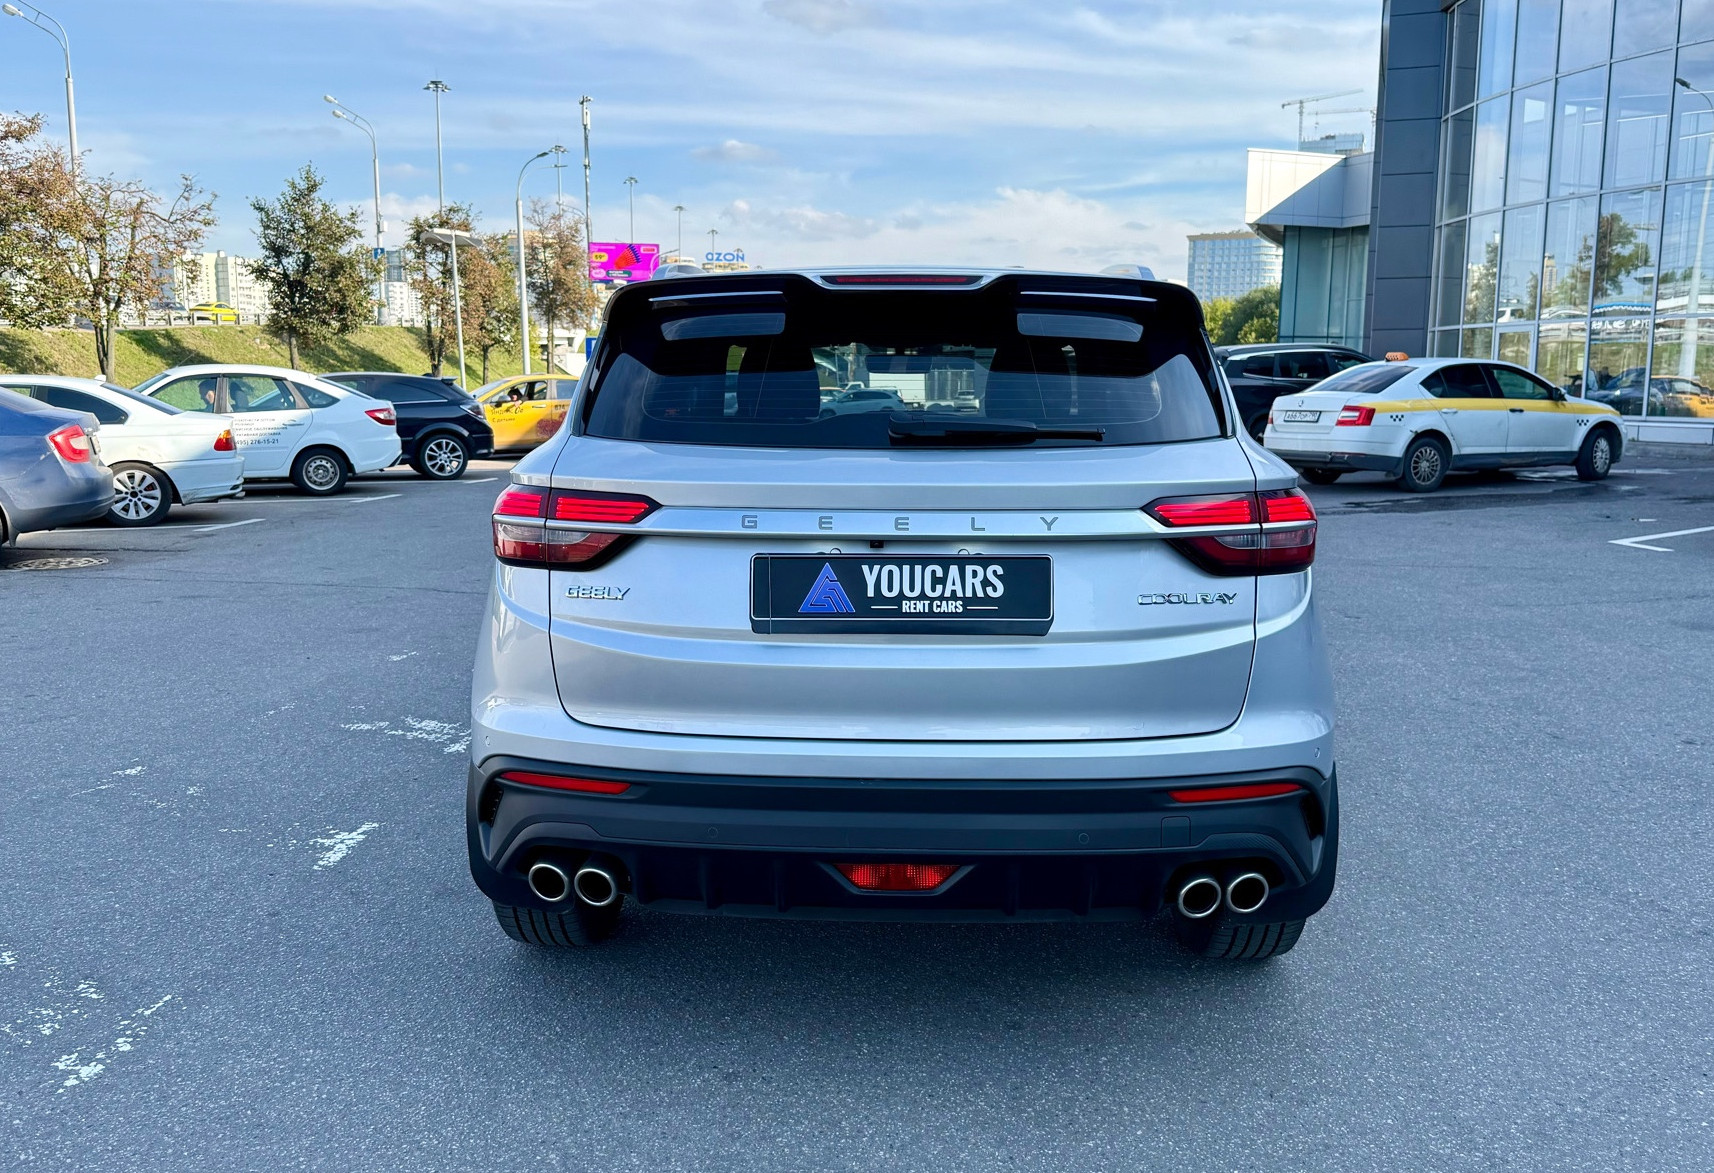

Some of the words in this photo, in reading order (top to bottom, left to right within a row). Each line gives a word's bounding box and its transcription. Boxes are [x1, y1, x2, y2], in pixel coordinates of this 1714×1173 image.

[861, 564, 1004, 598] YOUCARS
[565, 585, 632, 601] GEELY
[1137, 592, 1238, 606] COOLRAY
[902, 600, 930, 613] RENT
[932, 600, 963, 613] CARS
